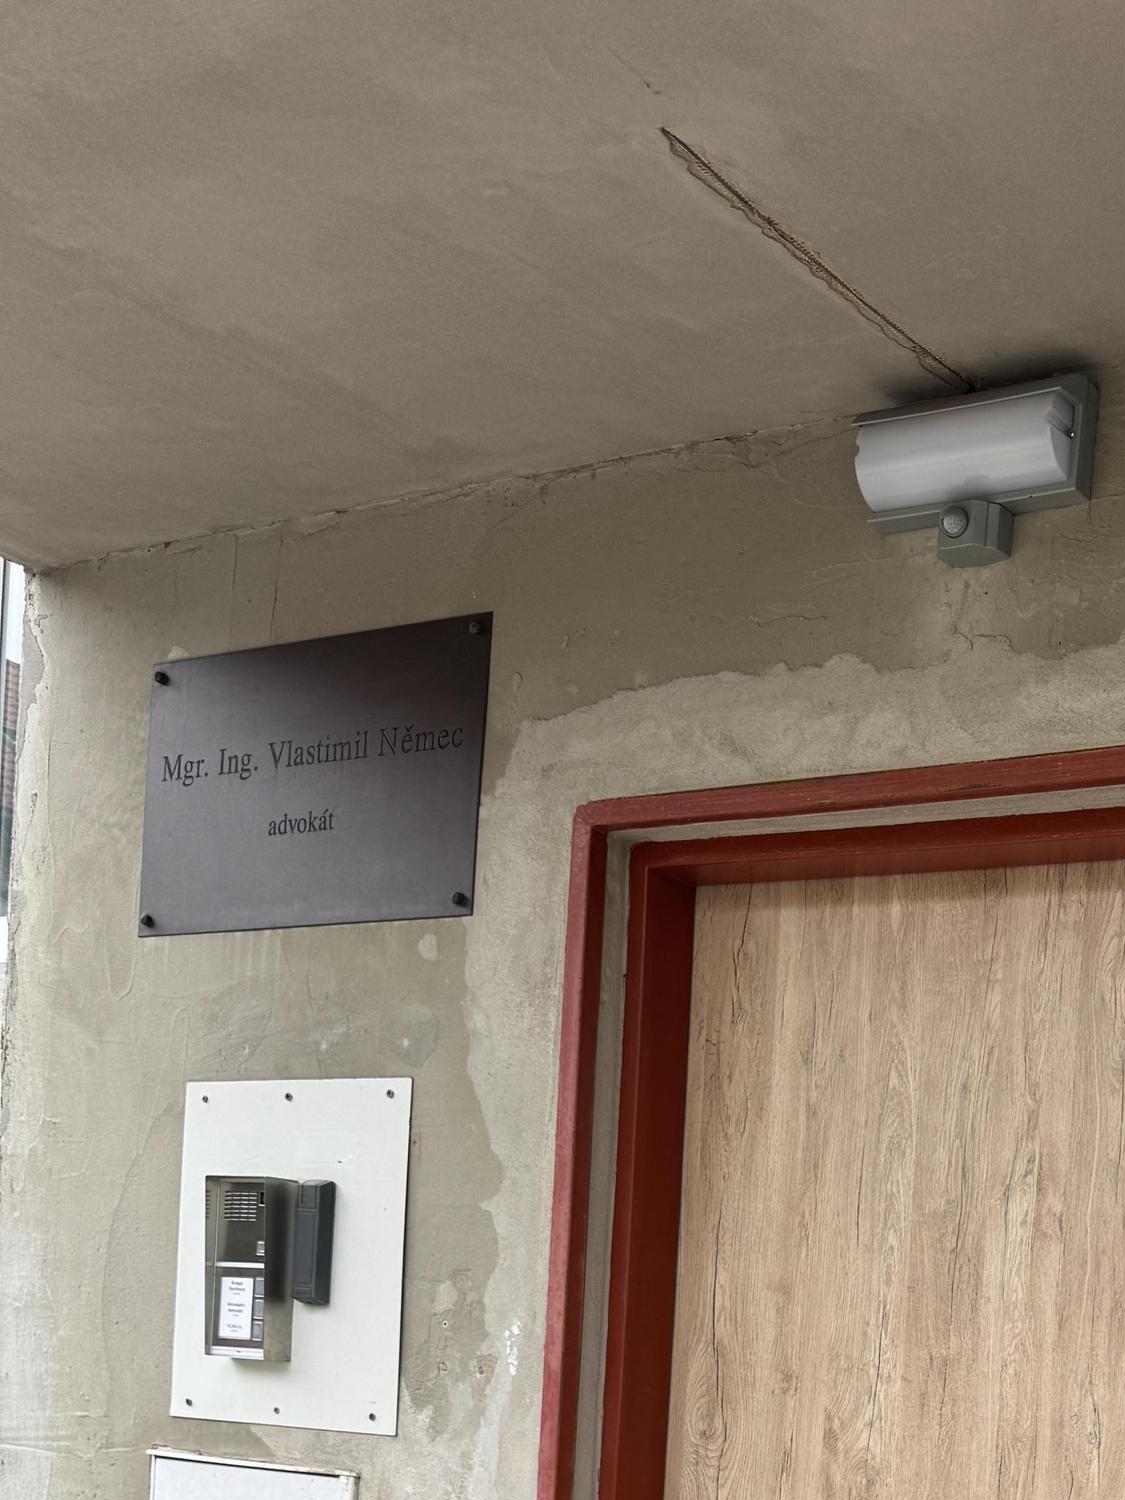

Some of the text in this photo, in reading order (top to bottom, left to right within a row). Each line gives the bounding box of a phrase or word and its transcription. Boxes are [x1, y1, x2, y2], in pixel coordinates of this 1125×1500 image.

[161, 725, 465, 787] Mgr. Ing. Vlastimil Němec
[268, 808, 335, 836] advokát
